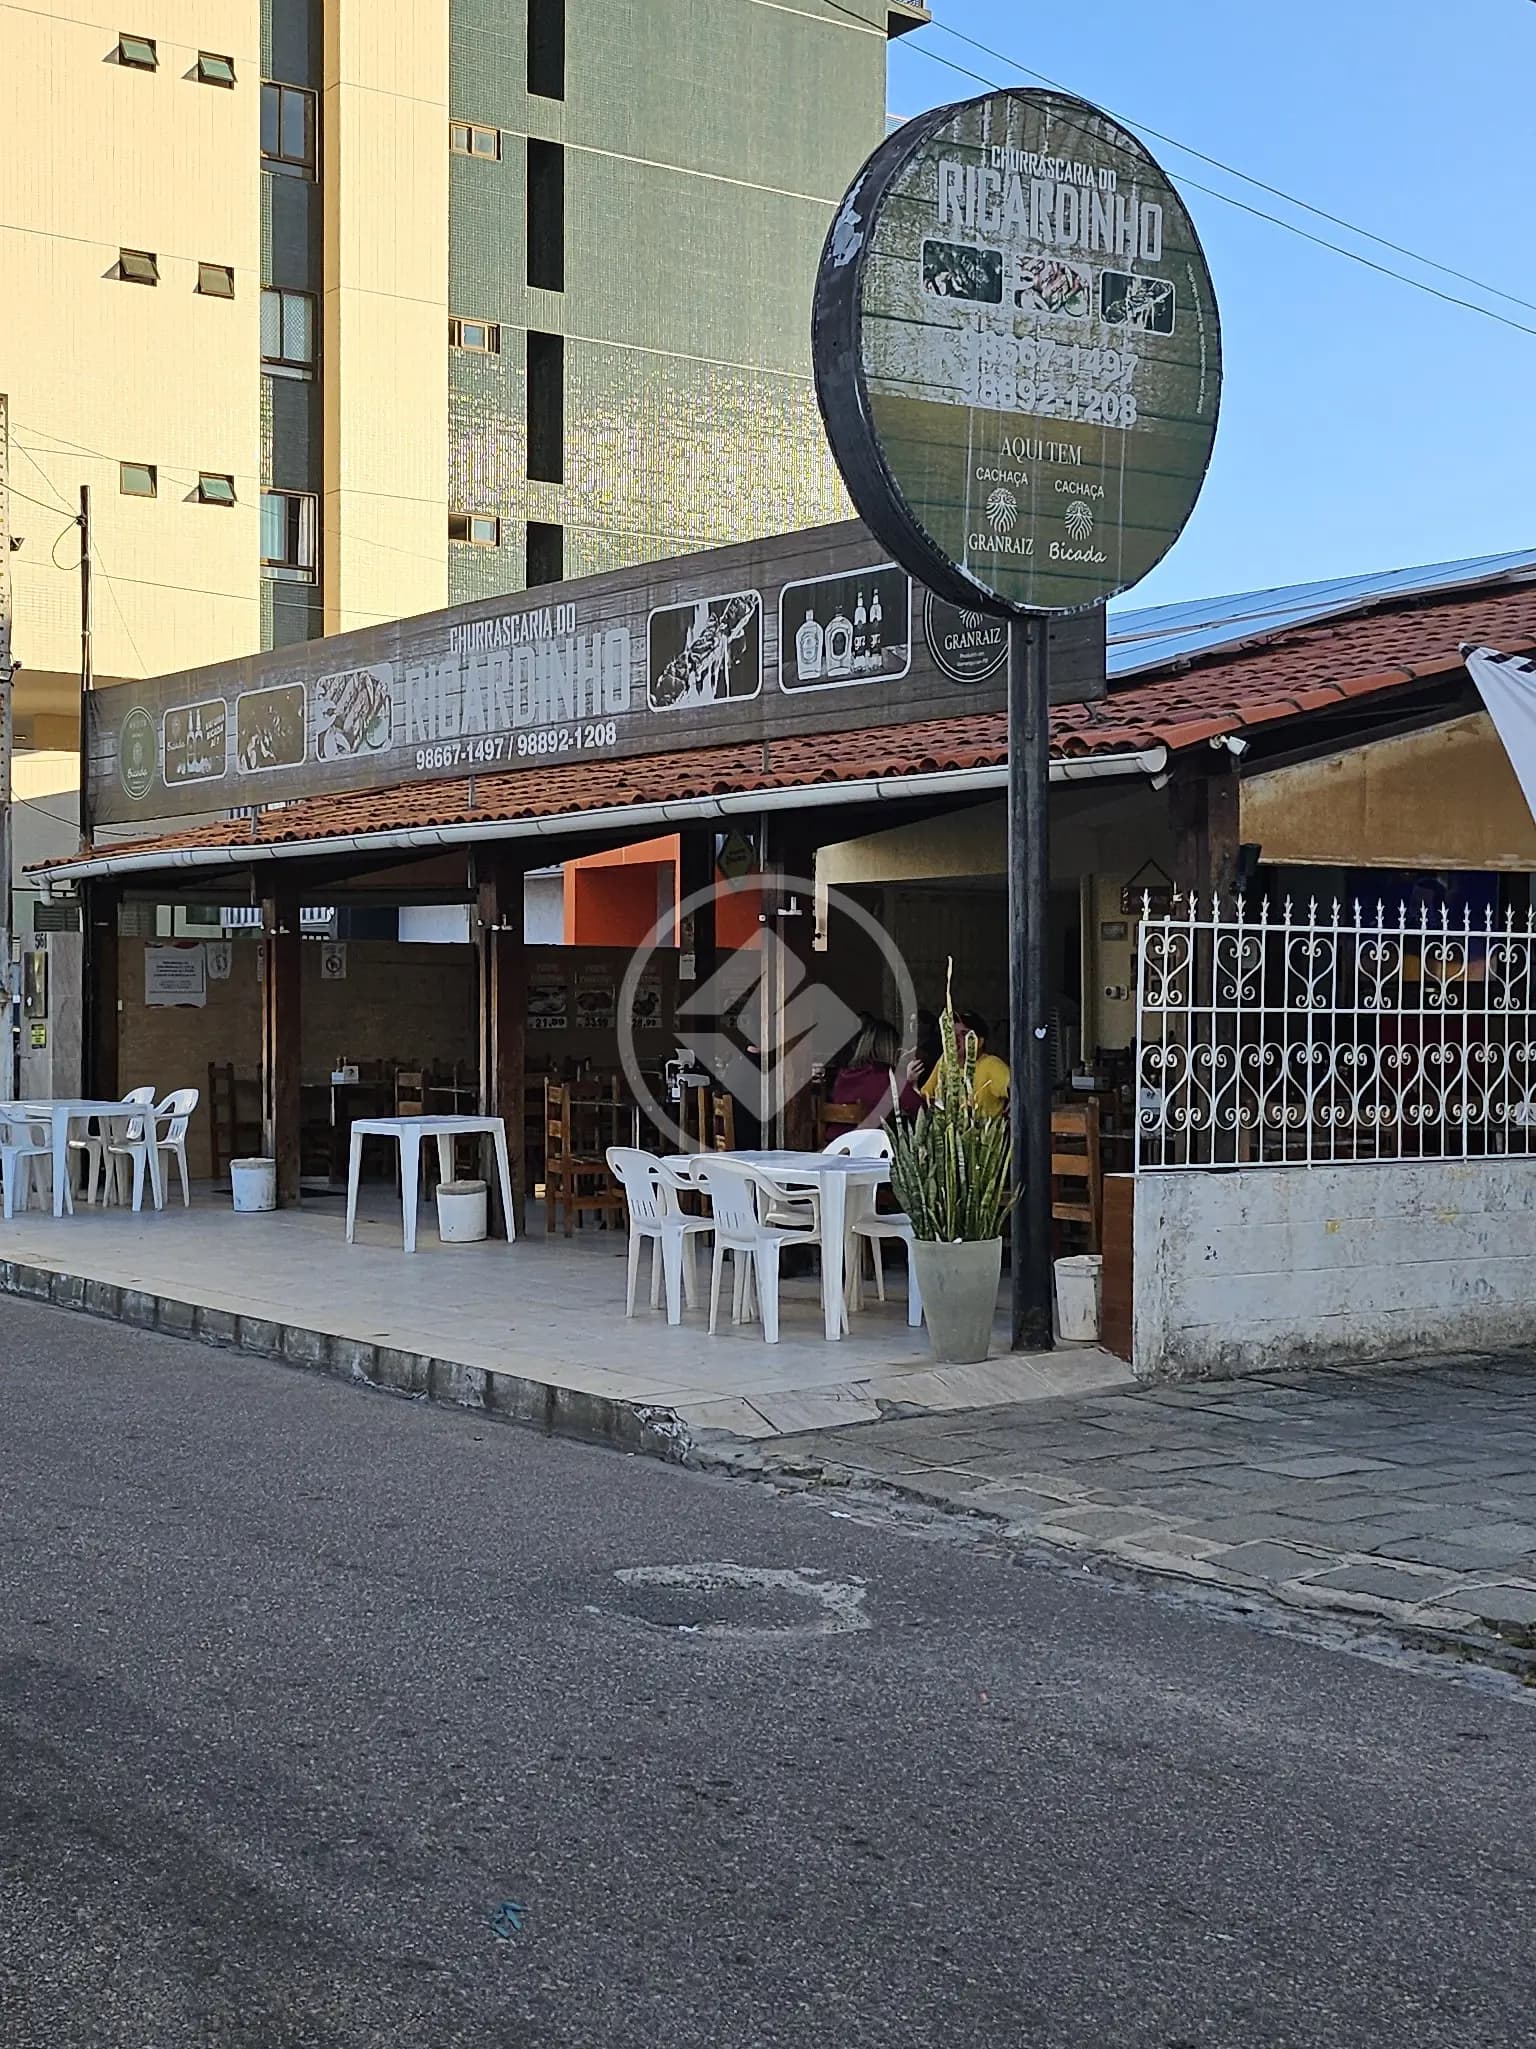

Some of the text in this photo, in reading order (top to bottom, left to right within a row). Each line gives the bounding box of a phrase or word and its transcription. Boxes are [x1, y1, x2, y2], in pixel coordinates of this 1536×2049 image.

[991, 145, 1117, 193] CHURRASCARIA DO
[938, 159, 1163, 262] RICARDINHO
[1000, 436, 1082, 466] AQUI TEM
[975, 467, 1029, 487] CACHAÇA
[1054, 479, 1105, 500] CACHAÇA
[968, 533, 1034, 555] GRANRAIZ
[1049, 541, 1107, 563] Bicada
[449, 602, 577, 654] CHURRASCARIA DO
[944, 627, 1001, 650] GRANRAIZ
[405, 627, 631, 744] RICARDINHO
[416, 737, 505, 771] 98667-1497
[517, 722, 617, 757] 98892-1208
